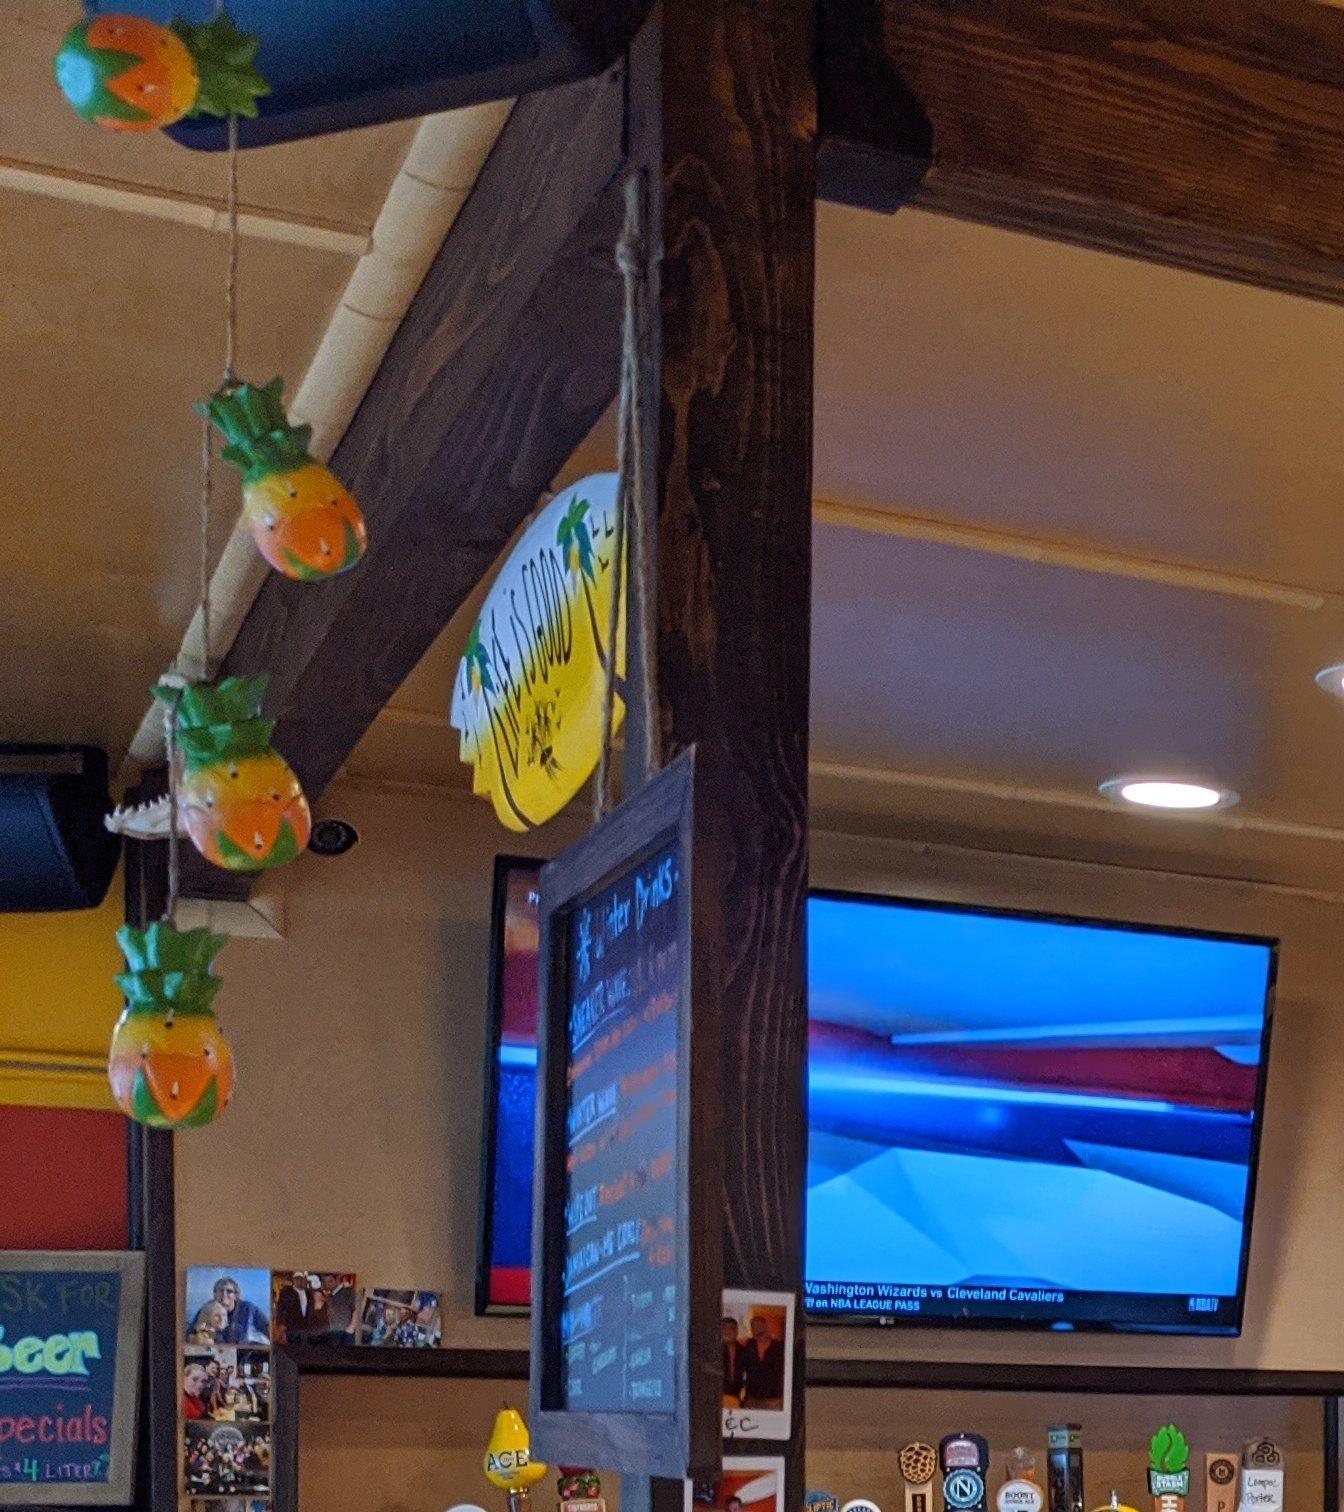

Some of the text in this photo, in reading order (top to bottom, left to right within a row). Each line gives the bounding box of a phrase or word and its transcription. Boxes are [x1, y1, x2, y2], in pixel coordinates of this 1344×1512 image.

[878, 1285, 928, 1299] Wizards
[947, 1288, 1008, 1301] Cleveland
[1009, 1289, 1065, 1303] Cavaliers
[487, 1450, 528, 1472] ACE
